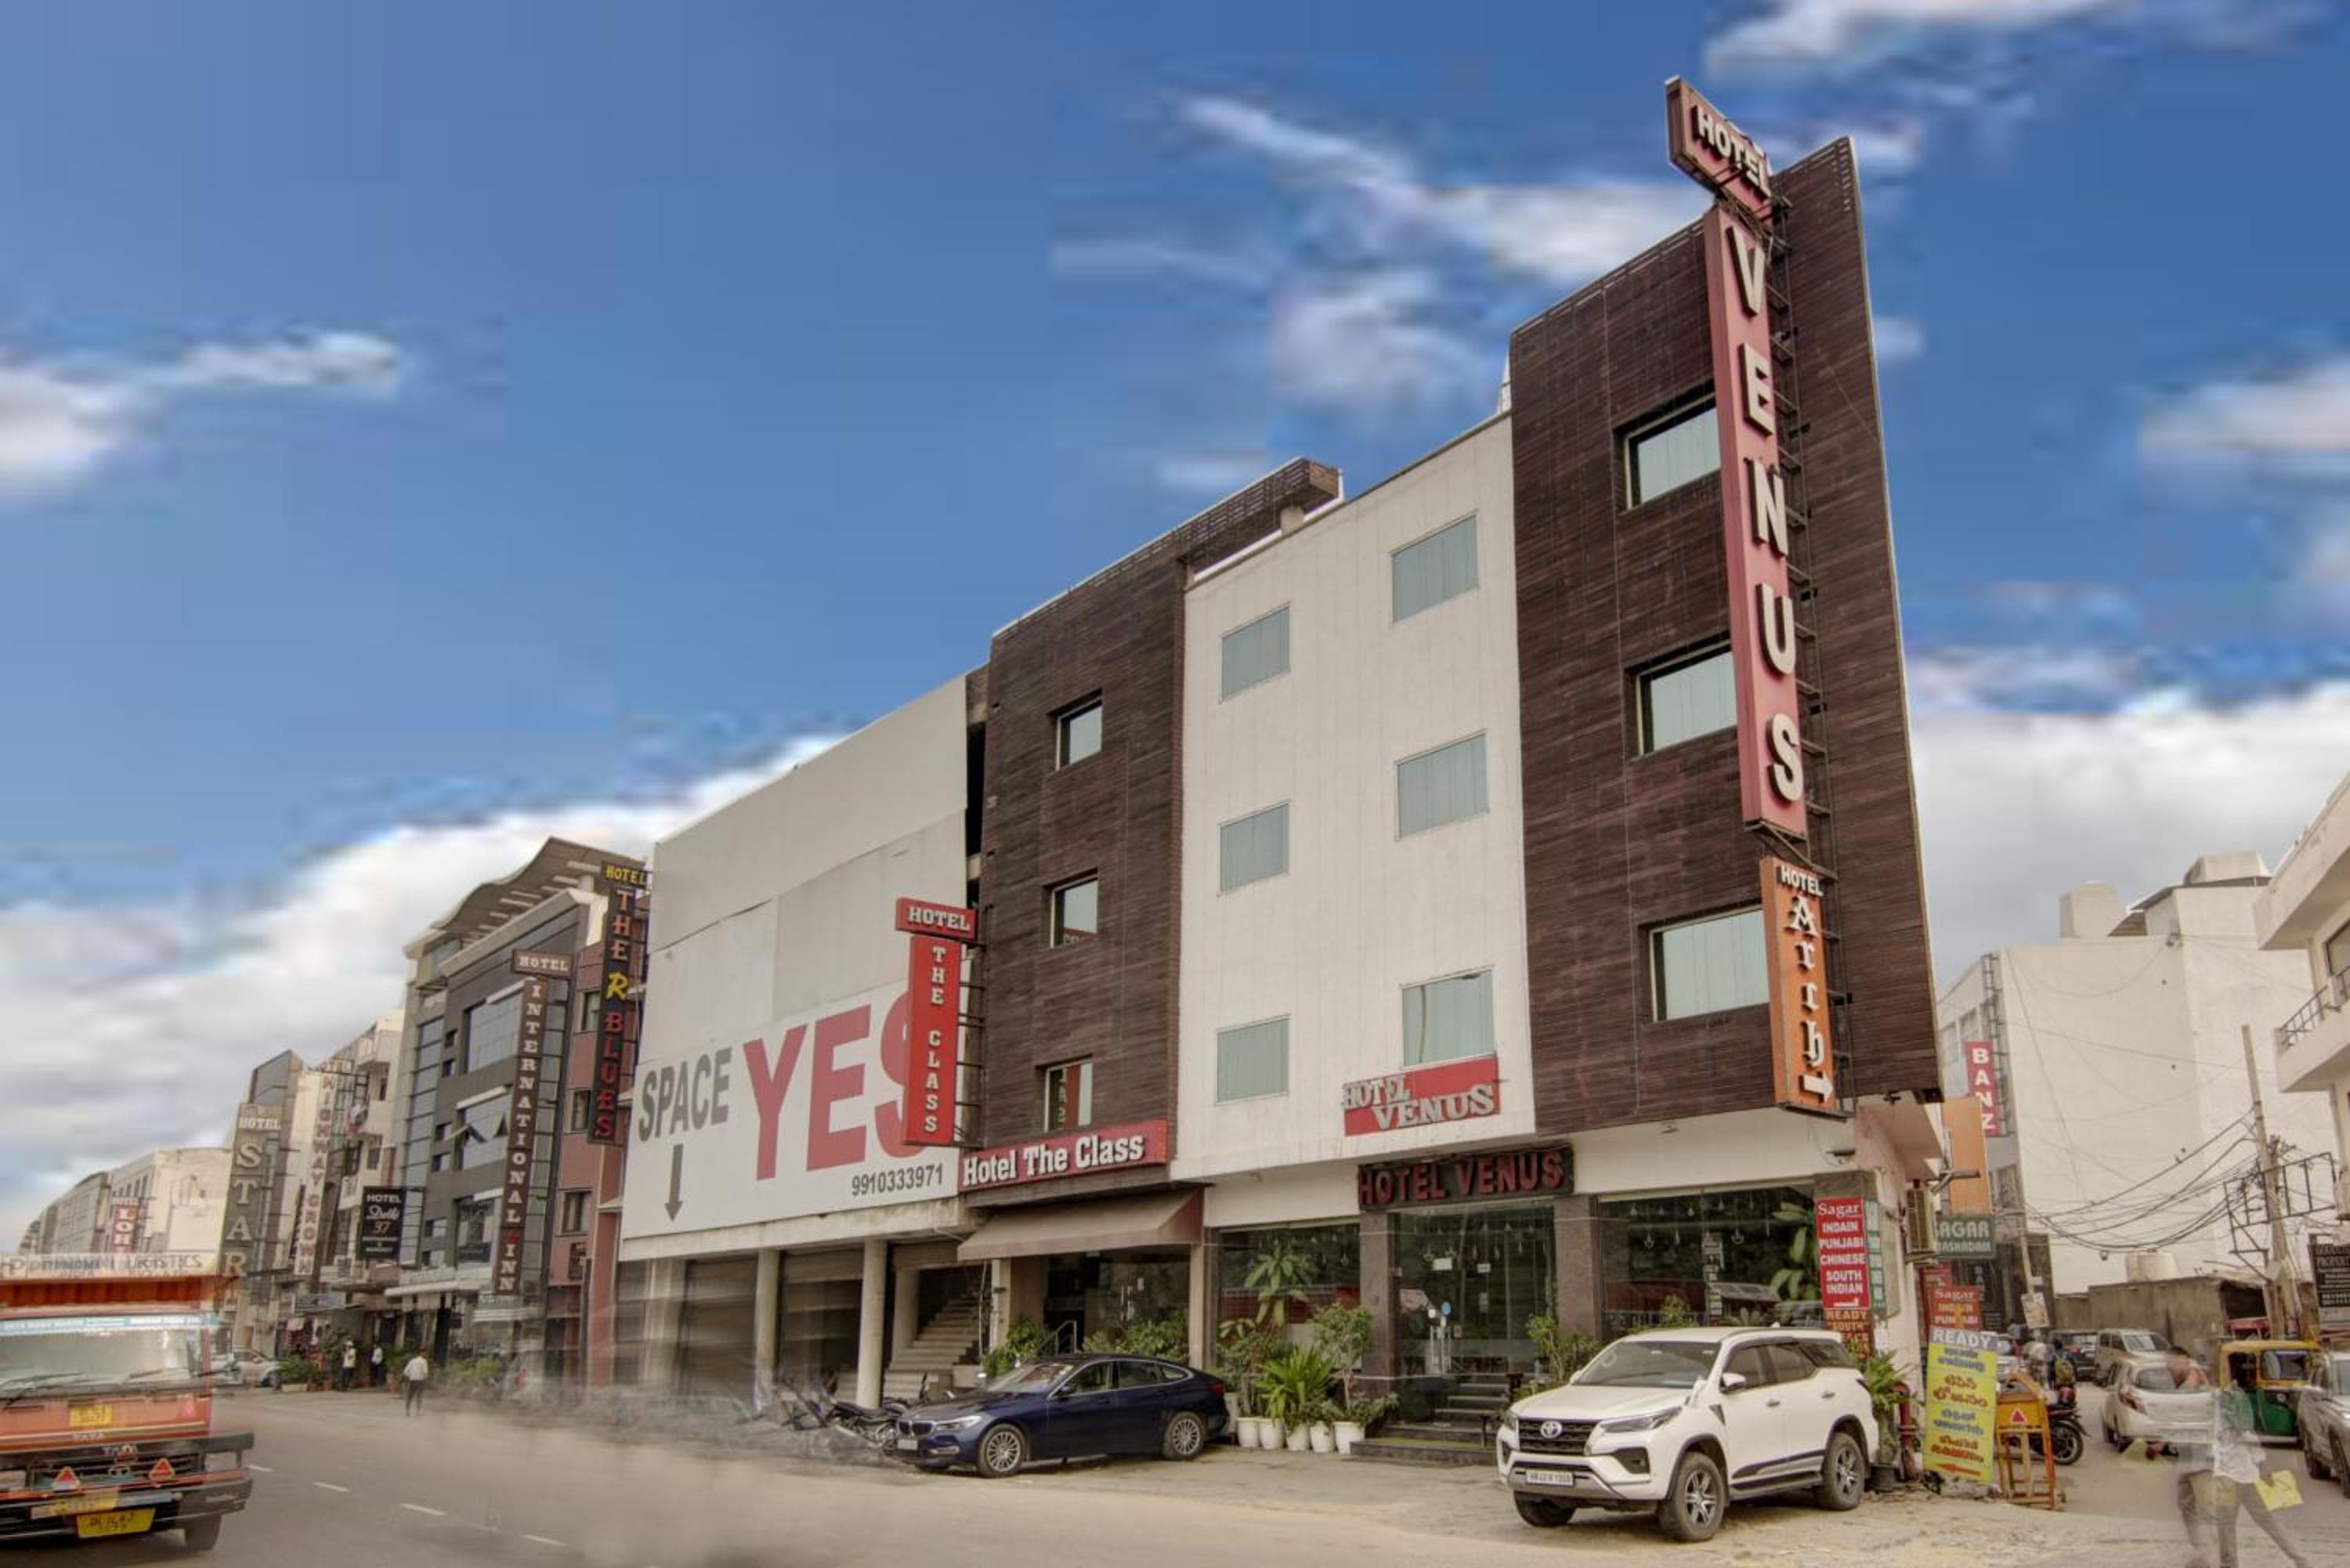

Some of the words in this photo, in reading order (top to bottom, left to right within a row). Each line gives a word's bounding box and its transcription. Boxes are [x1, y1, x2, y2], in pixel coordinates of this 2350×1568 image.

[1694, 105, 1773, 200] HOTEL
[1728, 225, 1804, 802] VENUS
[606, 865, 646, 886] HOTEL
[1780, 866, 1824, 896] HOTEL
[611, 890, 631, 961] THE
[909, 904, 971, 932] HOTEL
[519, 955, 568, 972] HOTEL
[931, 945, 946, 1006] THE
[607, 972, 627, 1001] R
[595, 1011, 624, 1137] BLUES
[924, 1029, 942, 1134] CLASS
[506, 984, 542, 1223] INTERNATIONAL
[638, 1046, 733, 1143] SPACE
[1342, 1073, 1412, 1111] HOTEL
[1372, 1085, 1493, 1130] VENUS
[239, 1116, 280, 1130] HOTEL
[963, 1149, 1017, 1187] Hotel
[1024, 1143, 1068, 1177] The
[1076, 1134, 1145, 1169] Class
[851, 1163, 943, 1196] 9910333971
[1359, 1162, 1448, 1205] HOTEL
[1454, 1150, 1565, 1196] VENUS
[367, 1193, 401, 1204] HOTEL
[1818, 1202, 1860, 1219] Sagar
[1819, 1237, 1864, 1249] PUNJABI
[1939, 1221, 1990, 1238] AGAR
[499, 1244, 518, 1291] INN
[1820, 1254, 1866, 1266] CHINESE
[1826, 1270, 1862, 1281] SOUTH
[1827, 1283, 1863, 1294] INDIAN
[1933, 1328, 1990, 1349] READY
